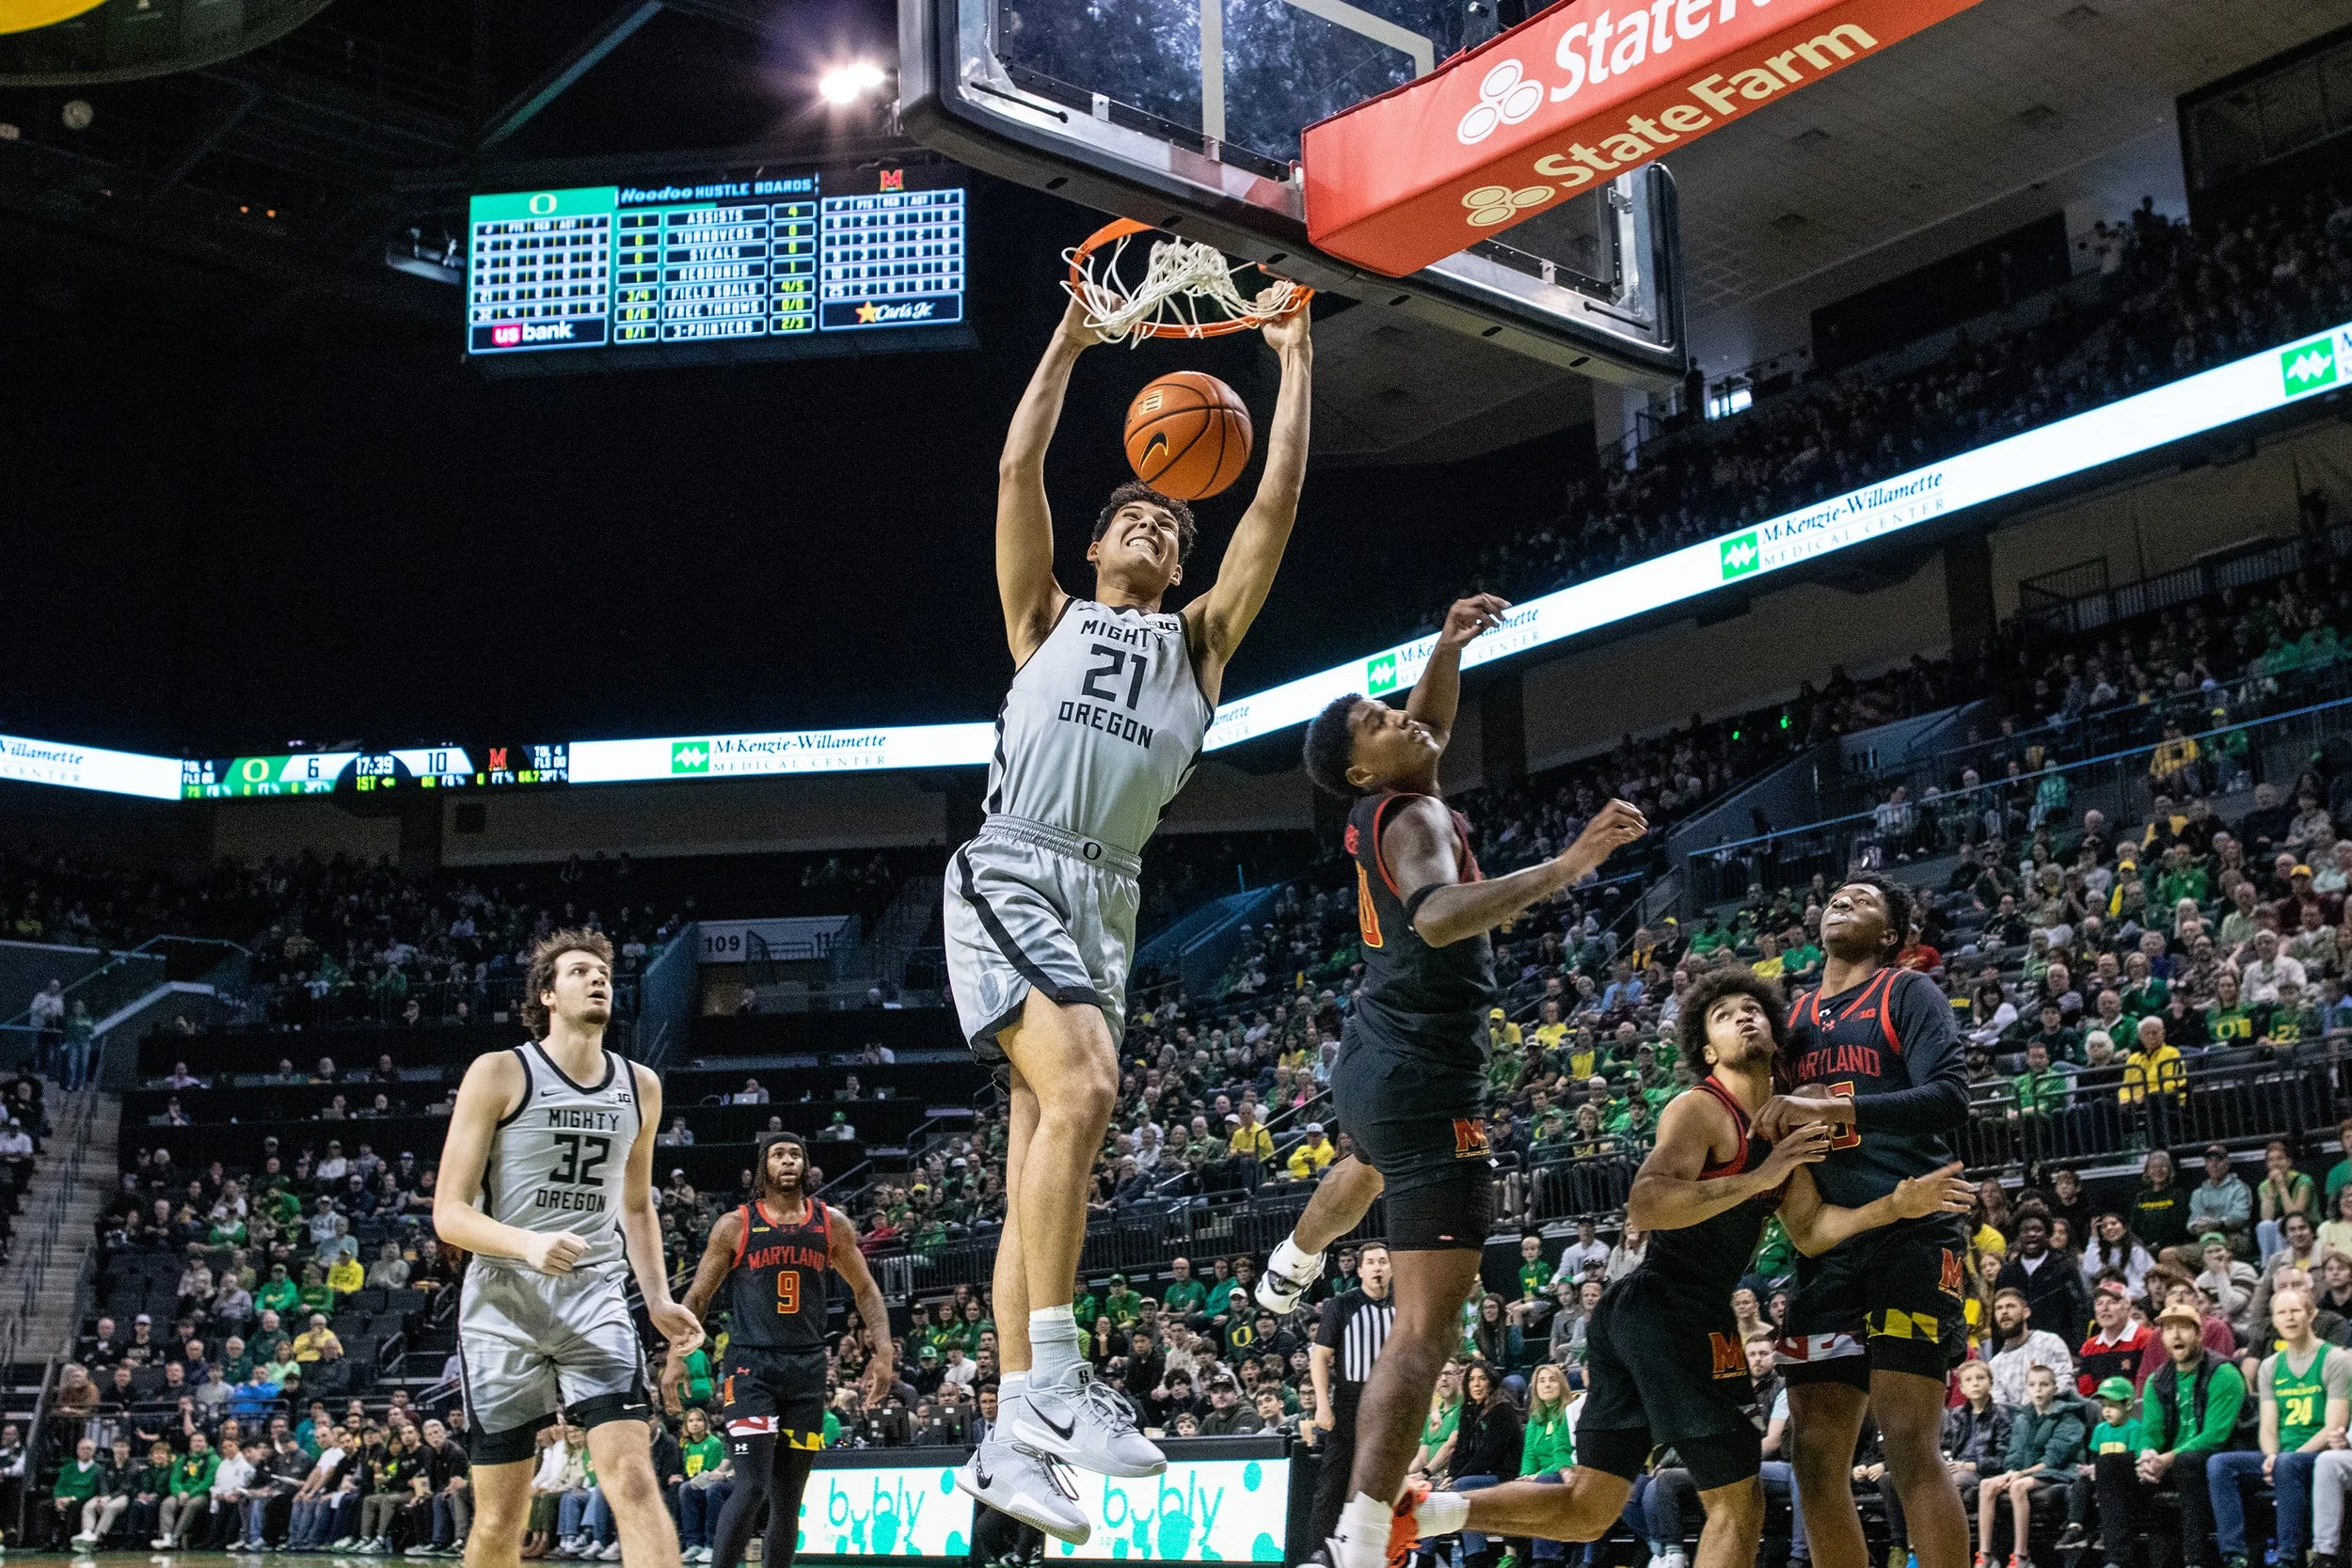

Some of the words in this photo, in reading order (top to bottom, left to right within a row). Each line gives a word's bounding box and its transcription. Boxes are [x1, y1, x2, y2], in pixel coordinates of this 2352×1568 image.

[621, 186, 693, 203] Hoodoo
[695, 182, 750, 198] HUSTLE
[755, 179, 813, 195] BOARDS
[638, 214, 644, 227] 1
[687, 208, 743, 225] ASSISTS
[787, 205, 798, 217] 4
[635, 233, 644, 246] 0
[677, 227, 754, 244] TURNOVERS
[788, 224, 798, 236] 0
[634, 251, 644, 263] 0
[690, 245, 740, 261] STEALS
[787, 241, 798, 254] 0
[635, 270, 642, 283] 1
[679, 263, 750, 280] REBOUNDS
[790, 260, 796, 273] 1
[627, 288, 649, 302] 3/4
[671, 286, 708, 301] FIELD
[713, 281, 756, 297] GOALS
[781, 278, 804, 293] 4/5
[626, 307, 649, 321] 0/0
[668, 304, 703, 319] FREE
[707, 299, 759, 316] THROWS
[781, 297, 804, 311] 0/0
[876, 302, 914, 321] Carl's
[521, 321, 573, 341] bank
[625, 325, 646, 340] 0/1
[674, 320, 753, 338] 3-POINTERS
[781, 315, 804, 330] 2/3
[1762, 473, 1943, 545] McKenzie-Willamette
[1764, 530, 1853, 566] MEDICAL
[1865, 499, 1946, 533] CENTER
[1080, 620, 1164, 652] MIGHTY
[1081, 642, 1148, 711] 21
[1057, 700, 1153, 749] OREGON
[715, 734, 886, 754] McKenzie-Willamette
[308, 757, 320, 778] 6
[357, 755, 395, 775] 17:39
[427, 752, 447, 772] 10
[489, 748, 507, 771] M
[533, 755, 550, 768] FLS
[714, 759, 802, 771] MEDICAL
[812, 755, 886, 768] CENTER
[356, 775, 376, 791] 1ST
[1083, 842, 1102, 861] O
[706, 935, 740, 953] 109
[1797, 1044, 1881, 1080] ARYLAND
[548, 1109, 619, 1132] MIGHTY
[548, 1133, 611, 1186] 32
[535, 1189, 607, 1212] OREGON
[747, 1245, 826, 1272] MARYLAND
[777, 1270, 801, 1314] 9
[1232, 1325, 1252, 1347] O
[1708, 1331, 1747, 1373] M
[2284, 1396, 2313, 1425] 24
